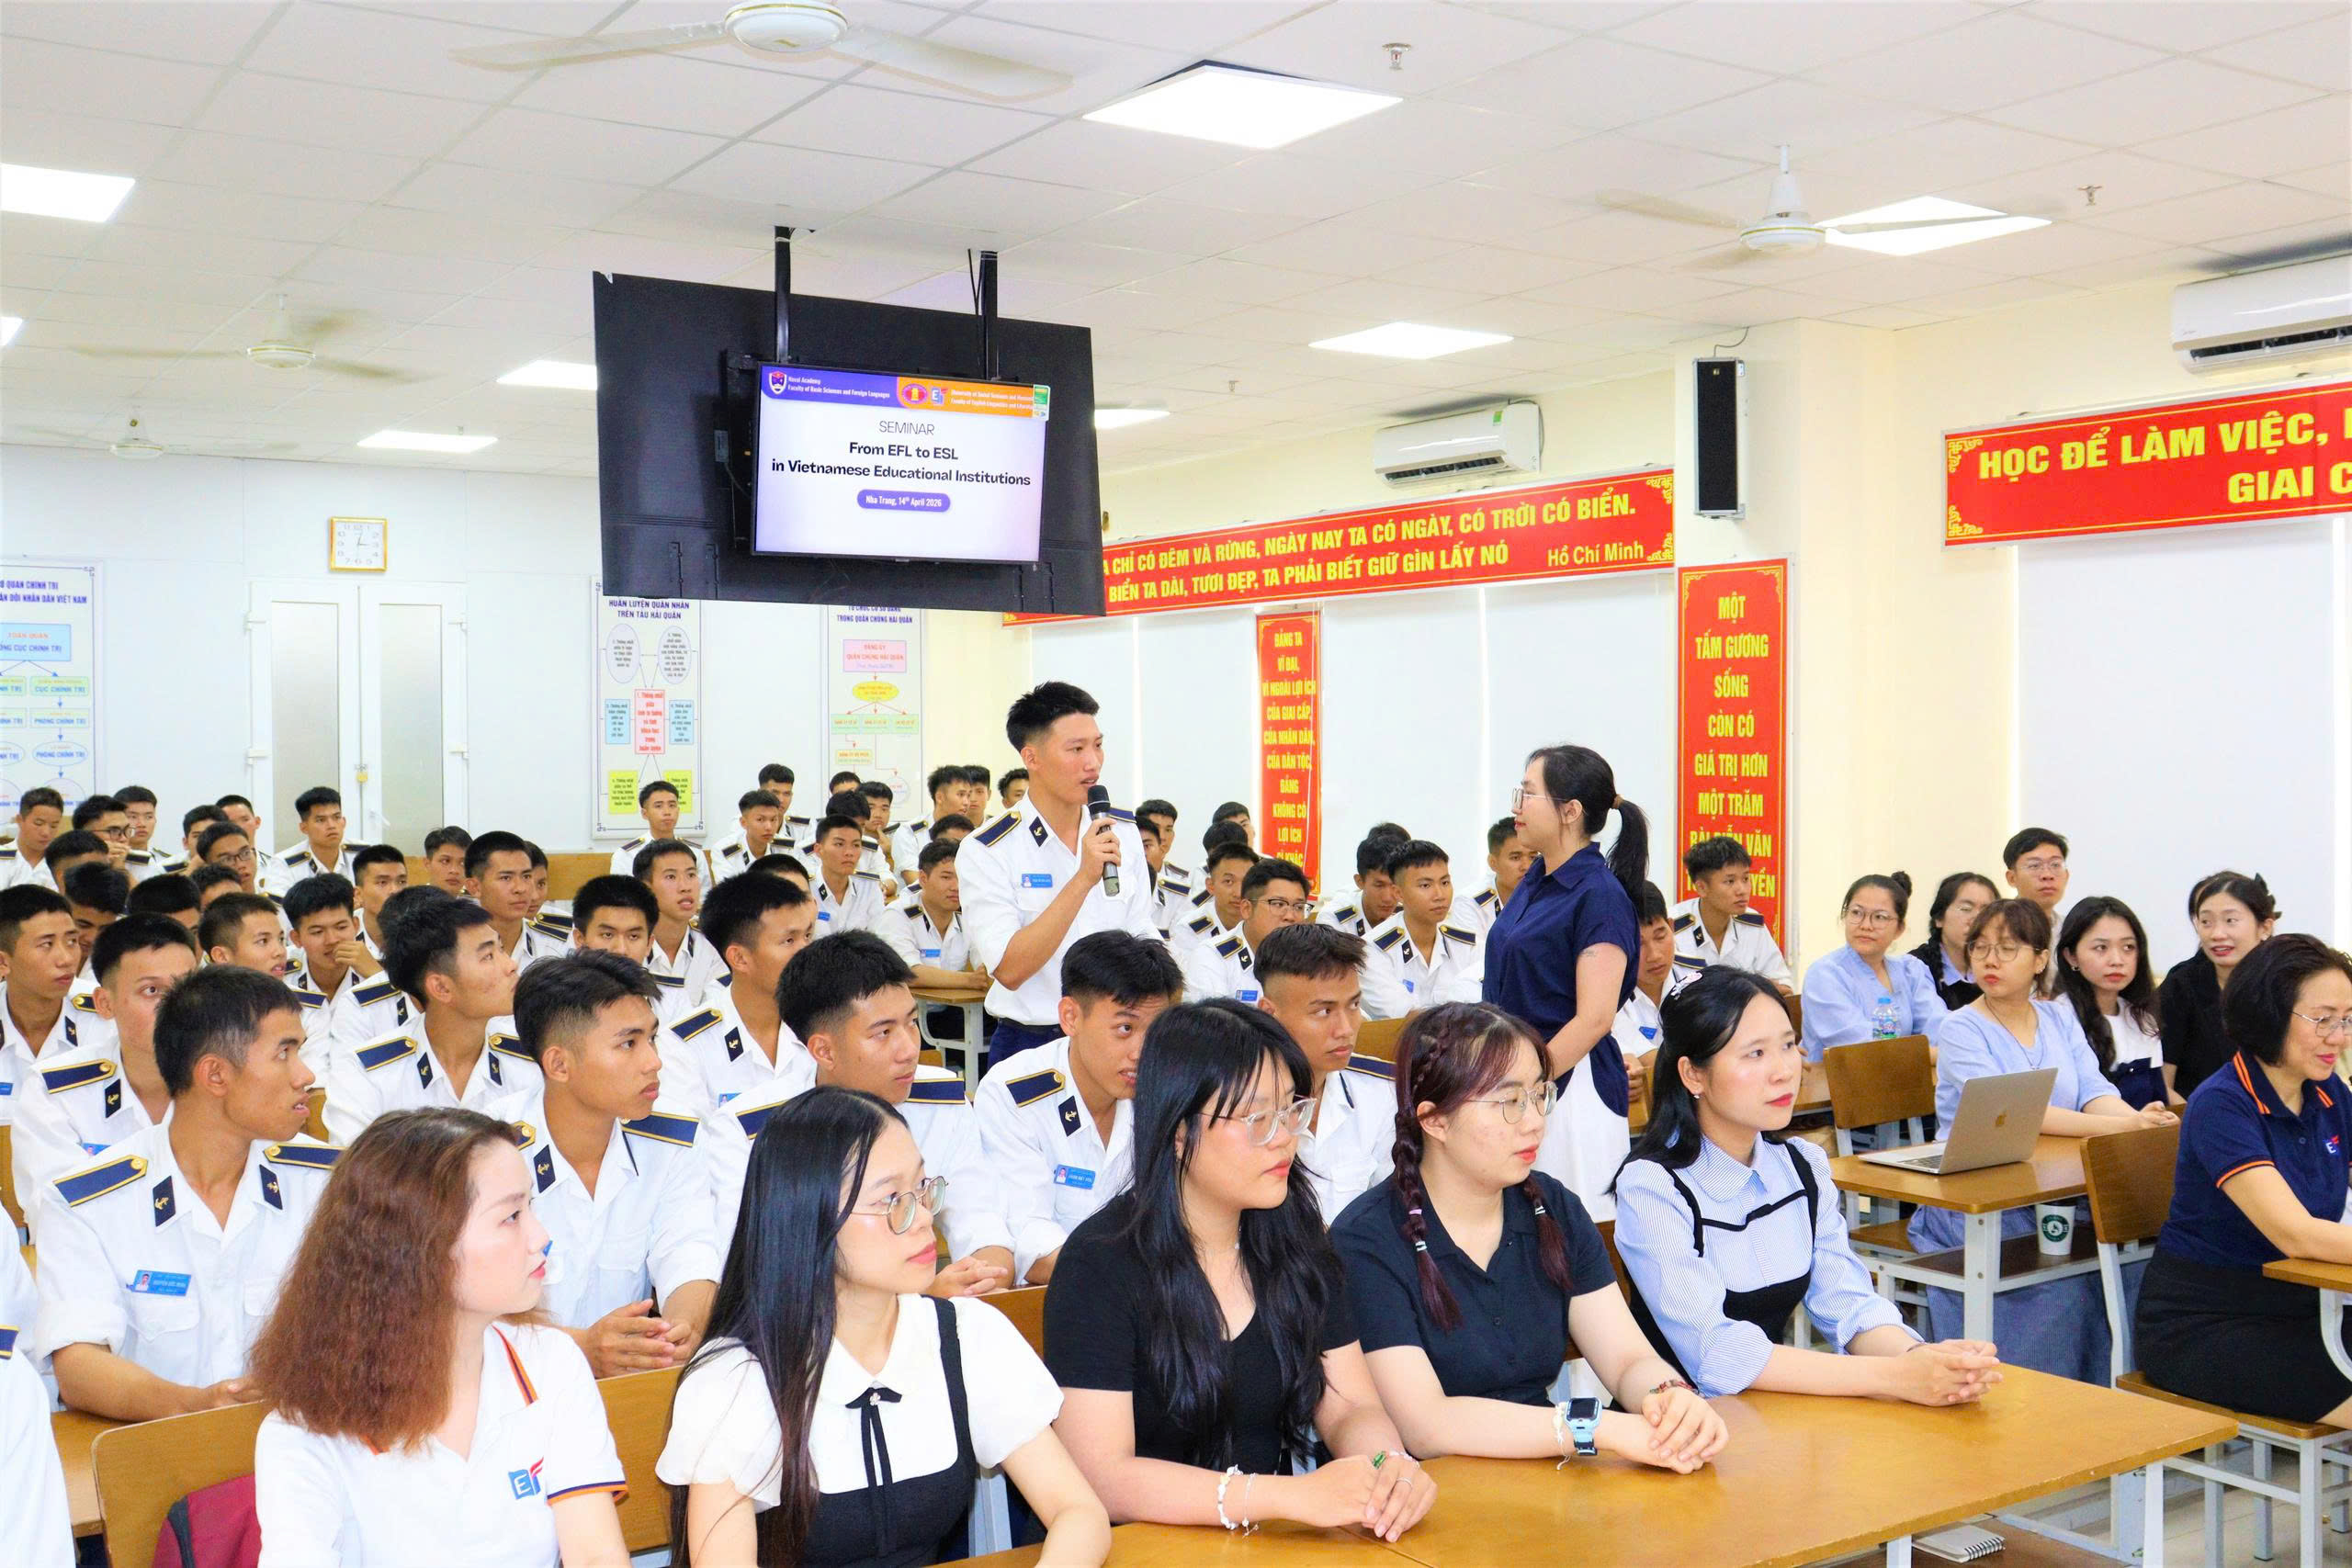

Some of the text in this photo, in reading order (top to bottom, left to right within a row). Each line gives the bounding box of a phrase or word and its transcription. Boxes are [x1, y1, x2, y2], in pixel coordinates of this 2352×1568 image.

[788, 384, 804, 392] Faculty
[823, 387, 842, 395] Sciences
[852, 389, 867, 397] Foreign
[868, 390, 890, 399] Languages
[801, 377, 821, 385] Academy
[878, 420, 935, 435] SEMINAR
[849, 442, 958, 460] From EFL to ESL
[1978, 446, 2049, 483] HỌC
[2061, 426, 2111, 471] ĐỂ
[2120, 425, 2206, 465] LÀM
[2219, 411, 2329, 455] VIỆC,
[772, 458, 1031, 486] in Vietnamese Educational Institutions
[2228, 465, 2314, 503] GIAI
[865, 495, 878, 505] Nha
[879, 496, 898, 506] Trang,
[910, 498, 925, 507] April
[925, 498, 942, 507] 2026
[1112, 551, 1135, 575] CHỈ
[1137, 549, 1156, 571] CÓ
[1159, 547, 1190, 570] ĐÊM
[1193, 543, 1212, 565] VÀ
[1216, 539, 1261, 562] RỪNG,
[1264, 531, 1307, 557] NGÀY
[1311, 529, 1344, 551] NAY
[1348, 526, 1368, 547] TA
[1373, 519, 1396, 544] CÓ
[1401, 513, 1453, 540] NGÀY,
[1459, 507, 1486, 534] CÓ
[1491, 502, 1536, 530] TRỜI
[1542, 497, 1571, 525] CÓ
[1577, 487, 1636, 520] BIỂN.
[1548, 540, 1644, 567] Hồ Chí Minh
[1108, 578, 1139, 603] BIỂN
[1142, 581, 1158, 599] TA
[1192, 572, 1224, 594] TƯƠI
[1227, 570, 1260, 593] ĐẸP,
[1262, 568, 1281, 587] TA
[1283, 558, 1322, 585] PHẢI
[1326, 554, 1363, 581] BIẾT
[1367, 552, 1399, 577] GIỮ
[1402, 548, 1435, 573] GÌN
[1440, 540, 1476, 570] LẤY
[1480, 539, 1509, 566] NÓ
[74, 595, 87, 604] NAM
[1718, 591, 1746, 624] MỘT
[1274, 628, 1303, 647] ĐẢNG TA
[1695, 628, 1770, 660] TẤM GƯƠNG
[1262, 677, 1317, 698] VÌ NGOÀI LỢI ÍCH
[1714, 667, 1749, 698] SỐNG
[1267, 701, 1281, 720] CỦA
[1282, 705, 1295, 720] GIAI
[1708, 708, 1755, 738] CÒN CÓ
[1263, 727, 1277, 745] CỦA
[1278, 728, 1297, 745] NHÂN
[1267, 750, 1281, 769] CỦA
[1282, 751, 1295, 769] DÂN
[1694, 749, 1768, 782] GIÁ TRỊ HƠN
[1280, 773, 1299, 794] ĐẢNG
[1272, 801, 1307, 818] KHÔNG CÓ
[1698, 788, 1764, 820] MỘT TRĂM
[1278, 827, 1302, 845] LỢI ÍCH
[1746, 829, 1771, 857] VĂN
